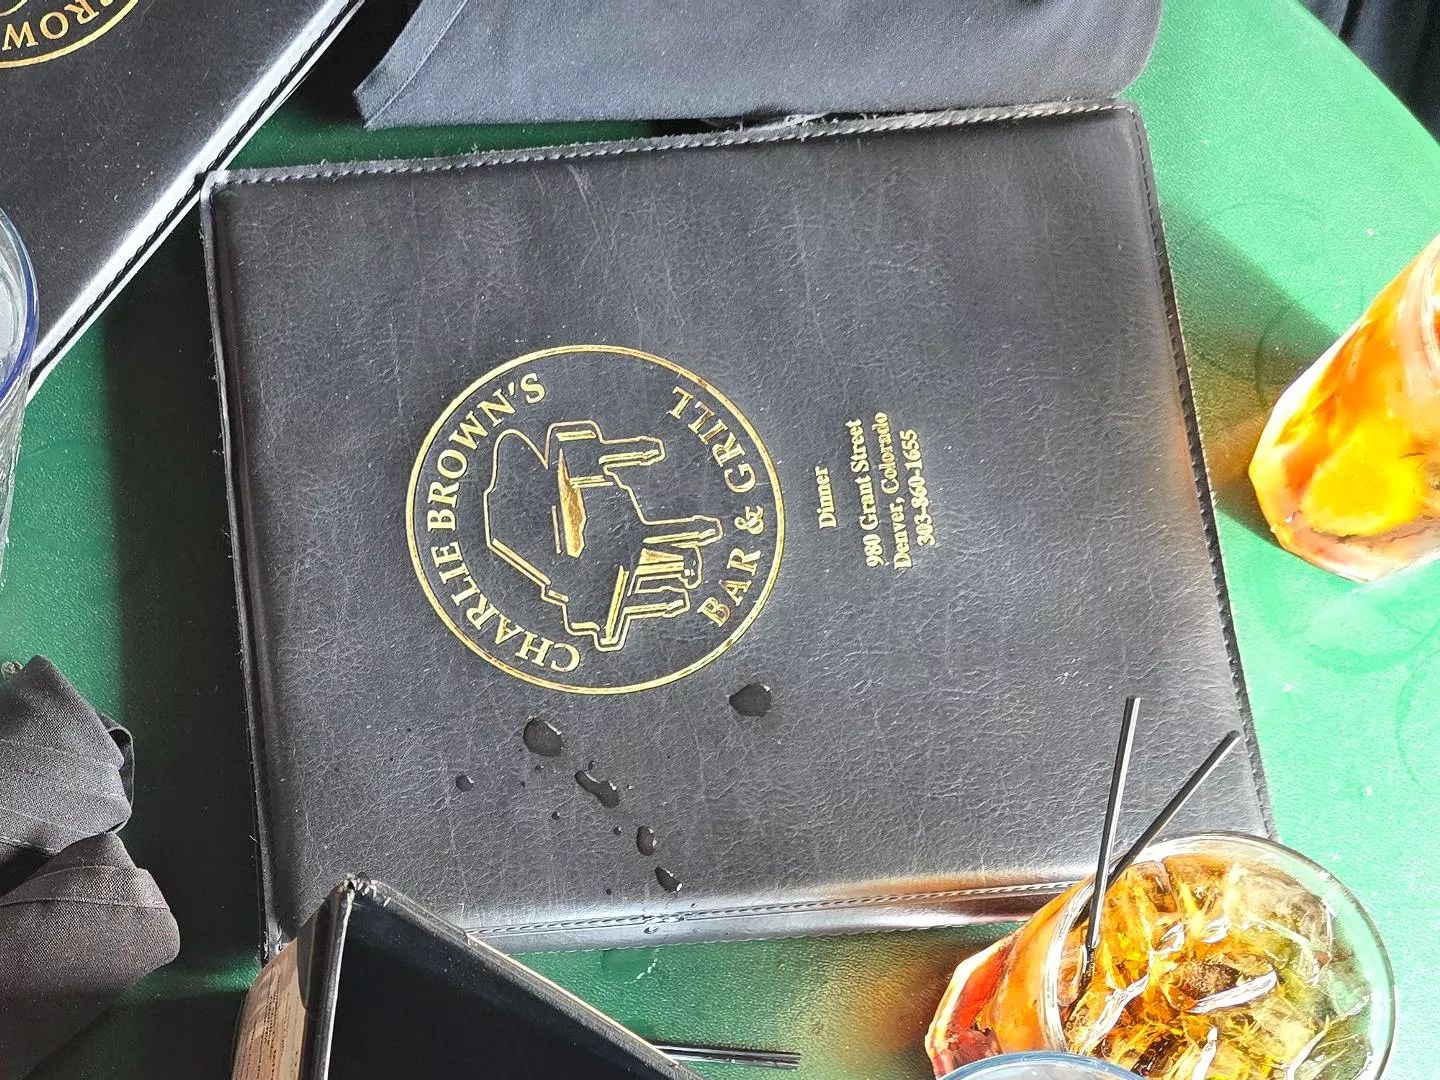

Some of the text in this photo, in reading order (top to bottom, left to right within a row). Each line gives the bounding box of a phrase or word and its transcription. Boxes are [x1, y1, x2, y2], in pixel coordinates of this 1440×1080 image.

[427, 372, 580, 673] CHARLIE BROWN'S
[668, 386, 764, 628] BAR & GRILL
[815, 465, 837, 529] Dinner
[845, 419, 885, 567] 980 Grant Street
[872, 412, 912, 569] Denver, Colorado
[899, 429, 936, 546] 303-860-1655
